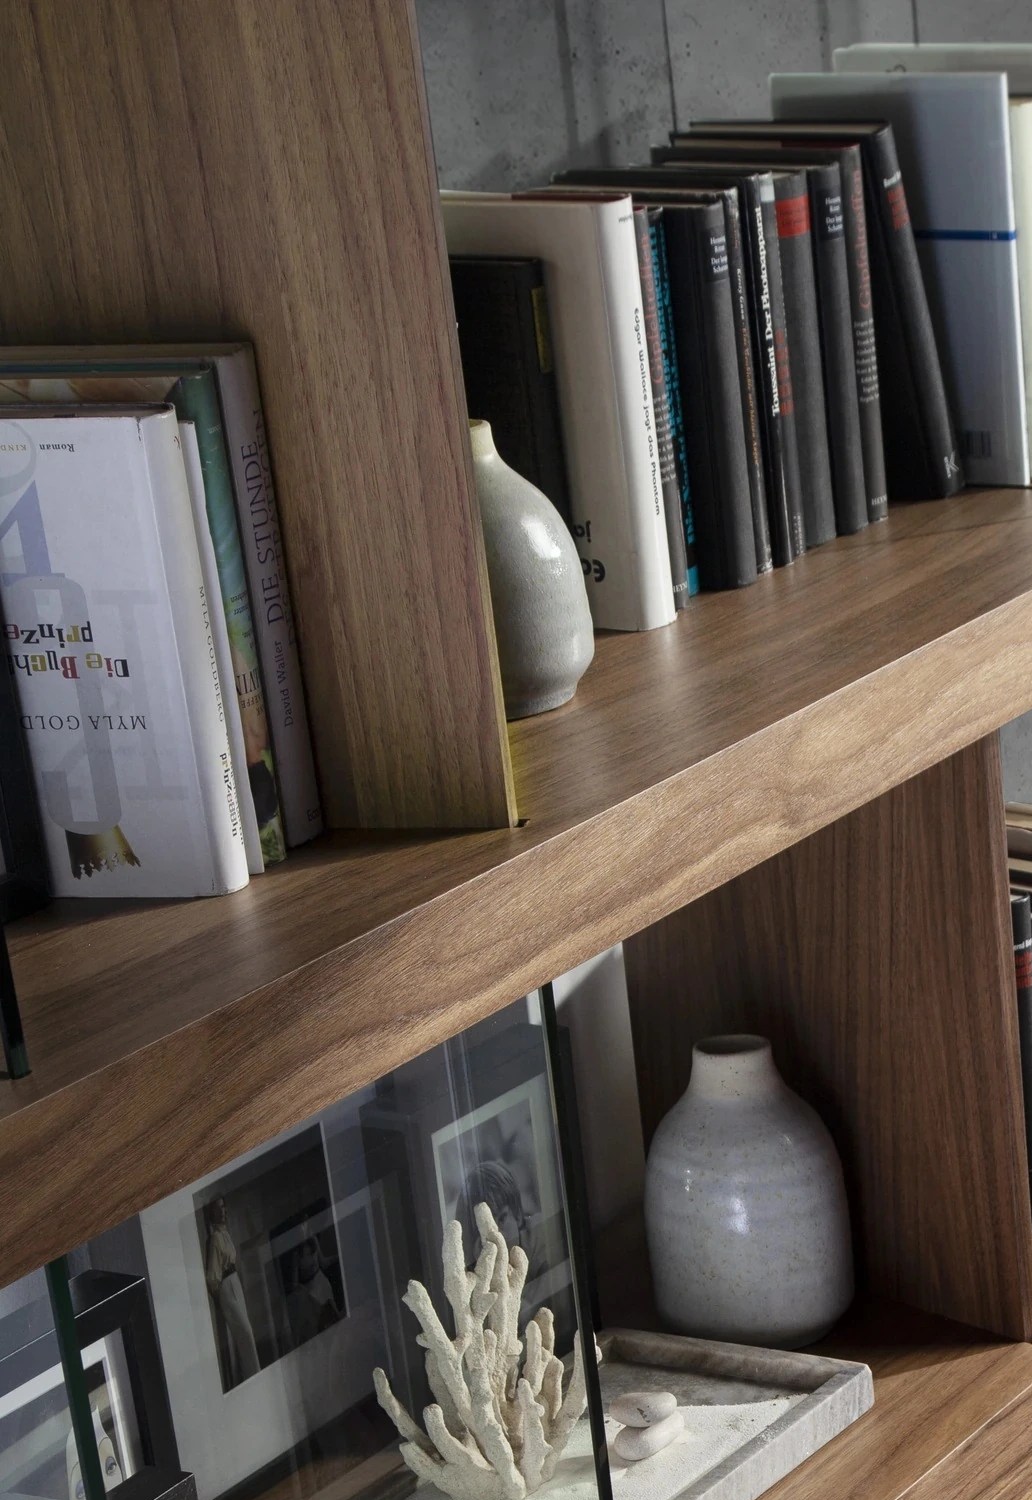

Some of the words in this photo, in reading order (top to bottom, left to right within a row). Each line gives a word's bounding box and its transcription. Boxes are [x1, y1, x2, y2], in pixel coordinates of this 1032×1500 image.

[767, 344, 781, 417] Toussaint
[643, 404, 652, 432] jagt
[39, 443, 75, 453] Roman
[241, 441, 276, 565] STUNDE
[261, 573, 285, 627] DIE
[85, 652, 130, 678] Die
[275, 640, 291, 683] Waller
[20, 715, 80, 730] GOLD
[87, 715, 147, 730] MYLA
[280, 686, 294, 728] David
